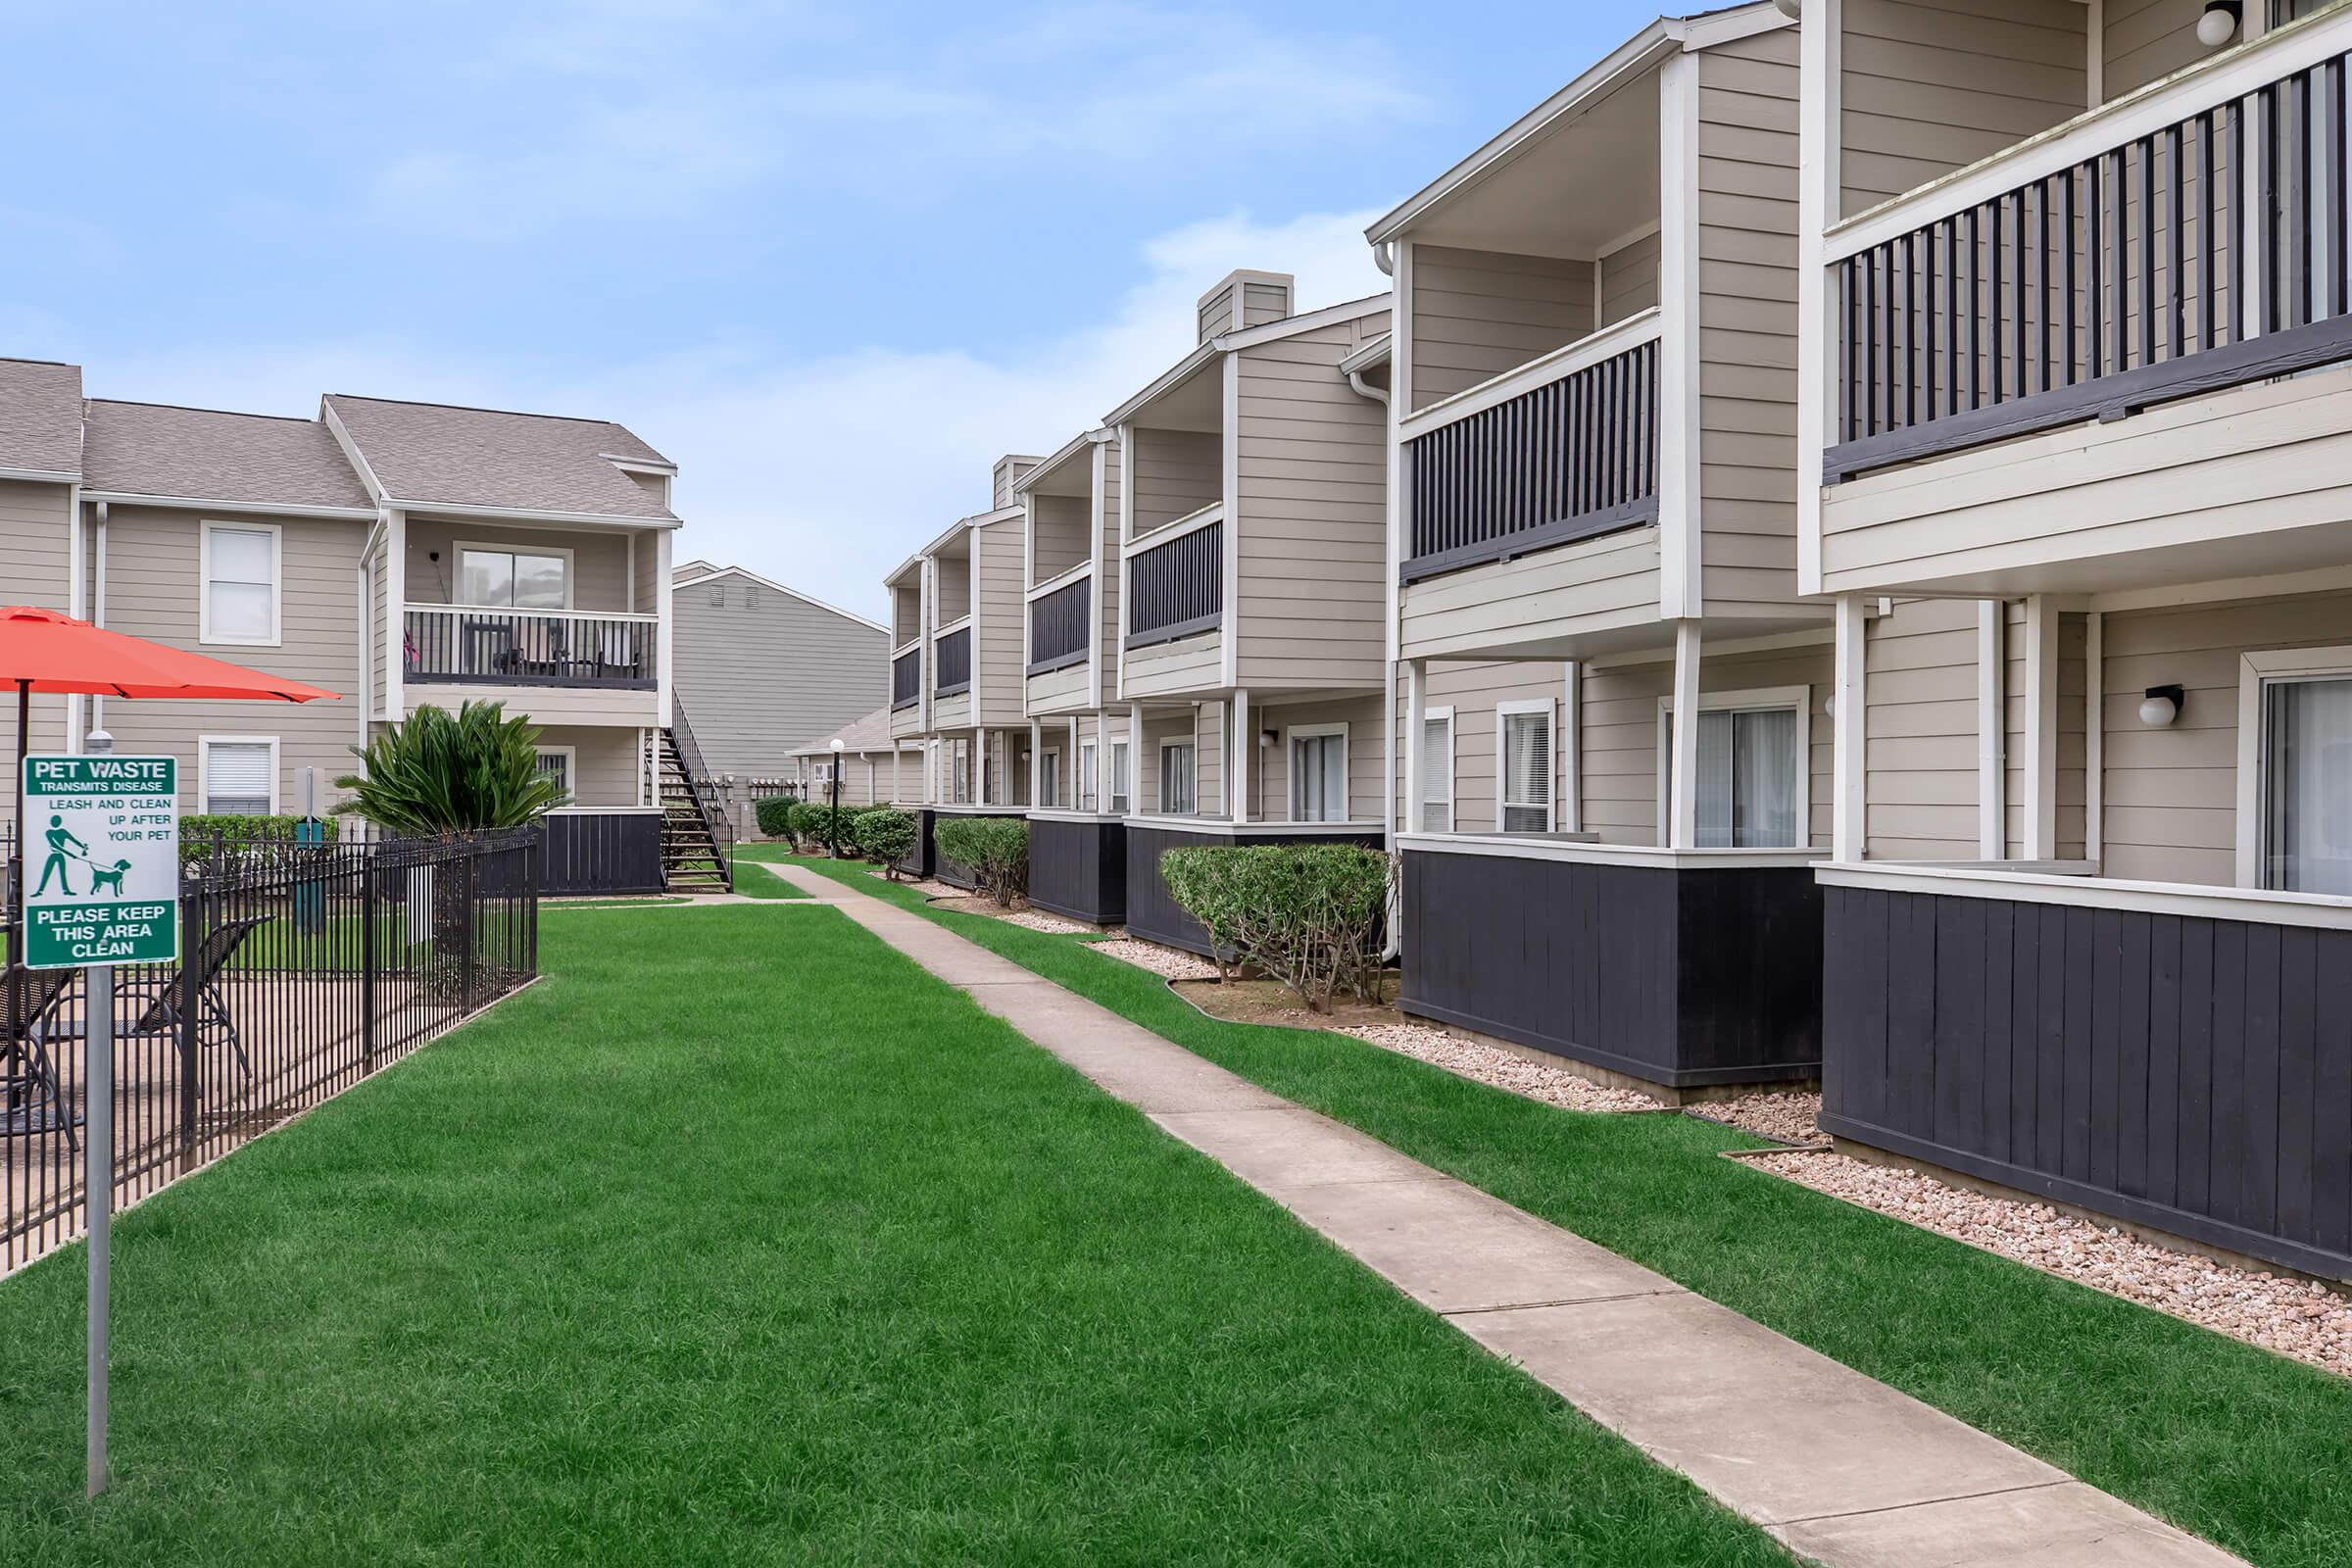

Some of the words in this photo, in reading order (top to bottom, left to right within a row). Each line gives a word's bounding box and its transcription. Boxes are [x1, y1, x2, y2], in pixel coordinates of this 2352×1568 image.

[35, 762, 79, 778] PET
[89, 762, 167, 778] WASTE
[41, 782, 109, 791] TRANSMITS
[114, 782, 163, 791] DISEASE
[50, 800, 92, 809] LEASH
[98, 800, 123, 808] AND
[130, 800, 171, 808] CLEAN
[110, 815, 125, 824] UP
[132, 815, 171, 824] AFTER
[109, 831, 145, 841] YOUR
[149, 831, 171, 840] PET
[38, 908, 110, 924] PLEASE
[118, 906, 165, 920] KEEP
[52, 927, 95, 941] THIS
[103, 925, 152, 938] AREA
[73, 942, 133, 957] CLEAN
